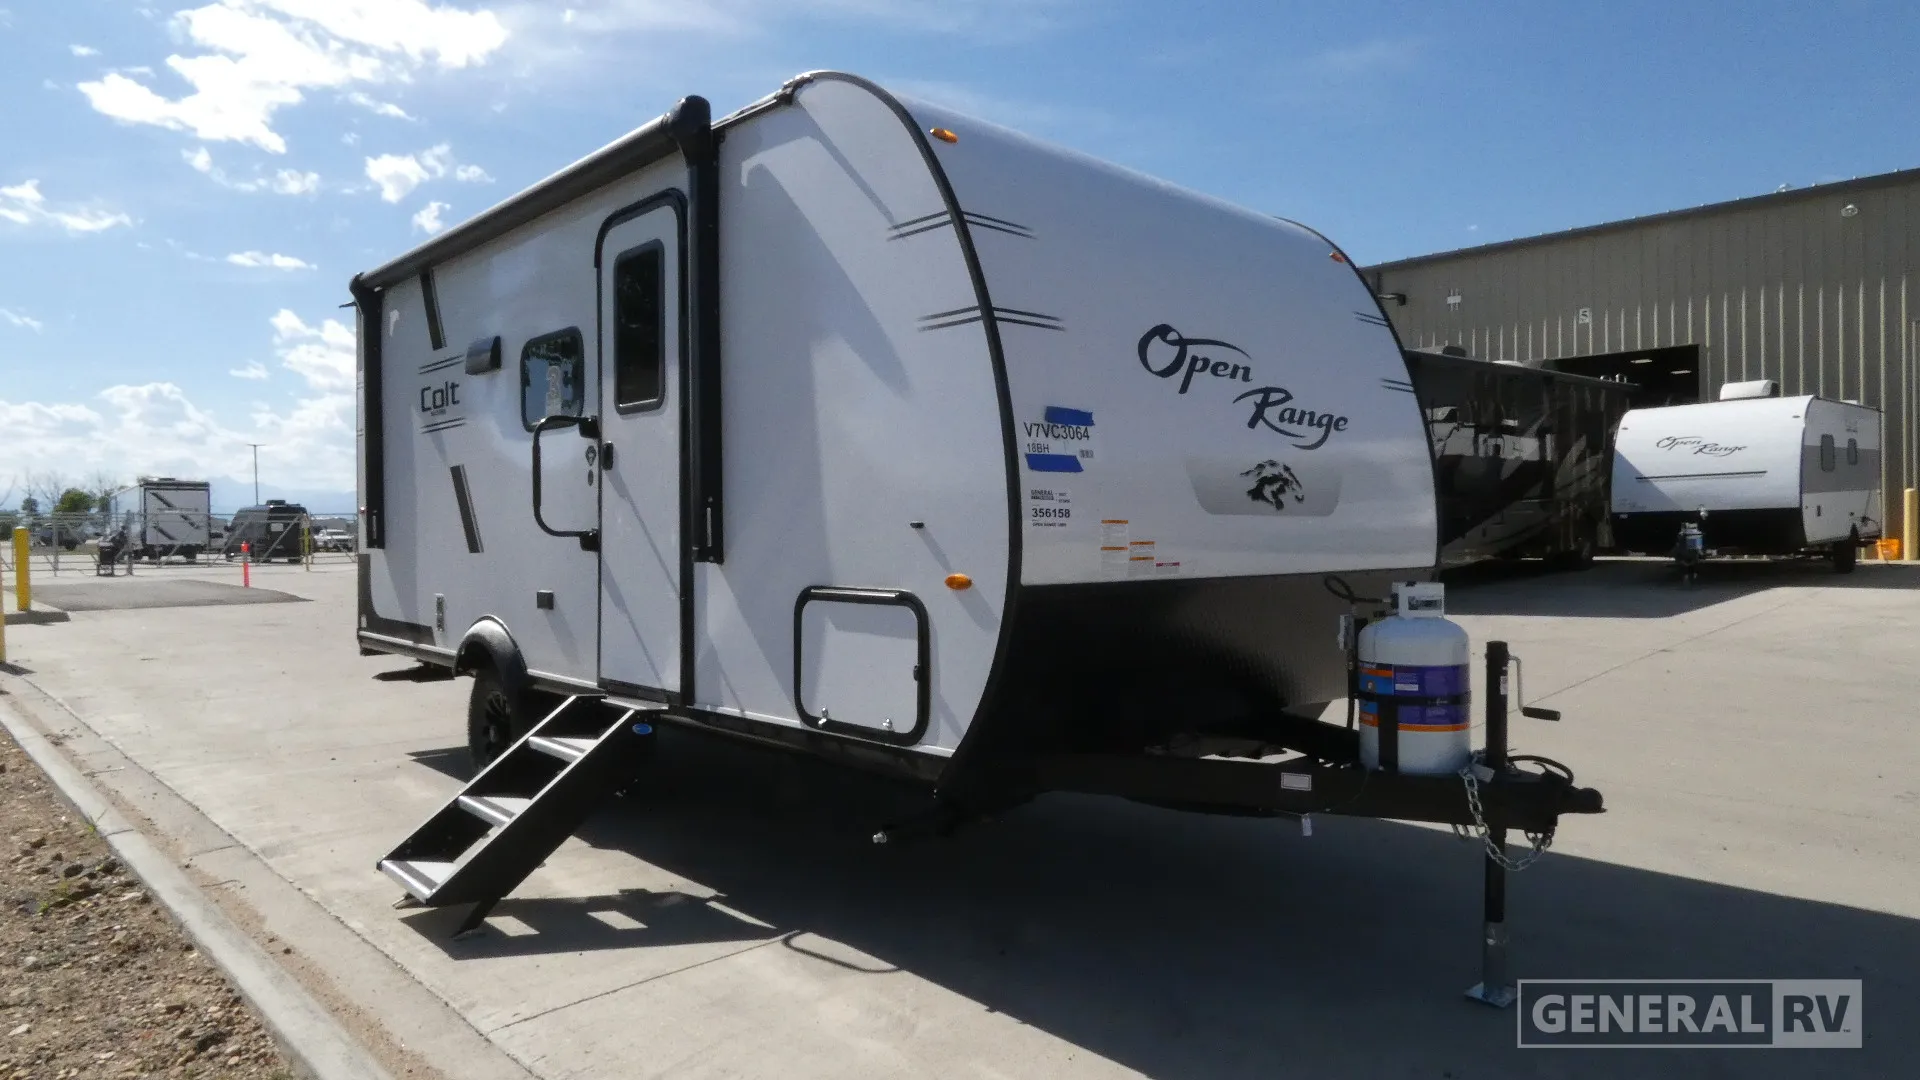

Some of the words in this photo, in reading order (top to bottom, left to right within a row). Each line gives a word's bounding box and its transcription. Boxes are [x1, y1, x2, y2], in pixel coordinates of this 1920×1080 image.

[1138, 324, 1253, 394] Open
[421, 381, 460, 412] Colt
[1233, 386, 1348, 451] Range
[1023, 422, 1090, 440] V7VC3064
[1027, 443, 1050, 453] 18BH
[1656, 435, 1703, 451] Open
[1693, 442, 1748, 457] Range
[1032, 508, 1071, 518] 356158
